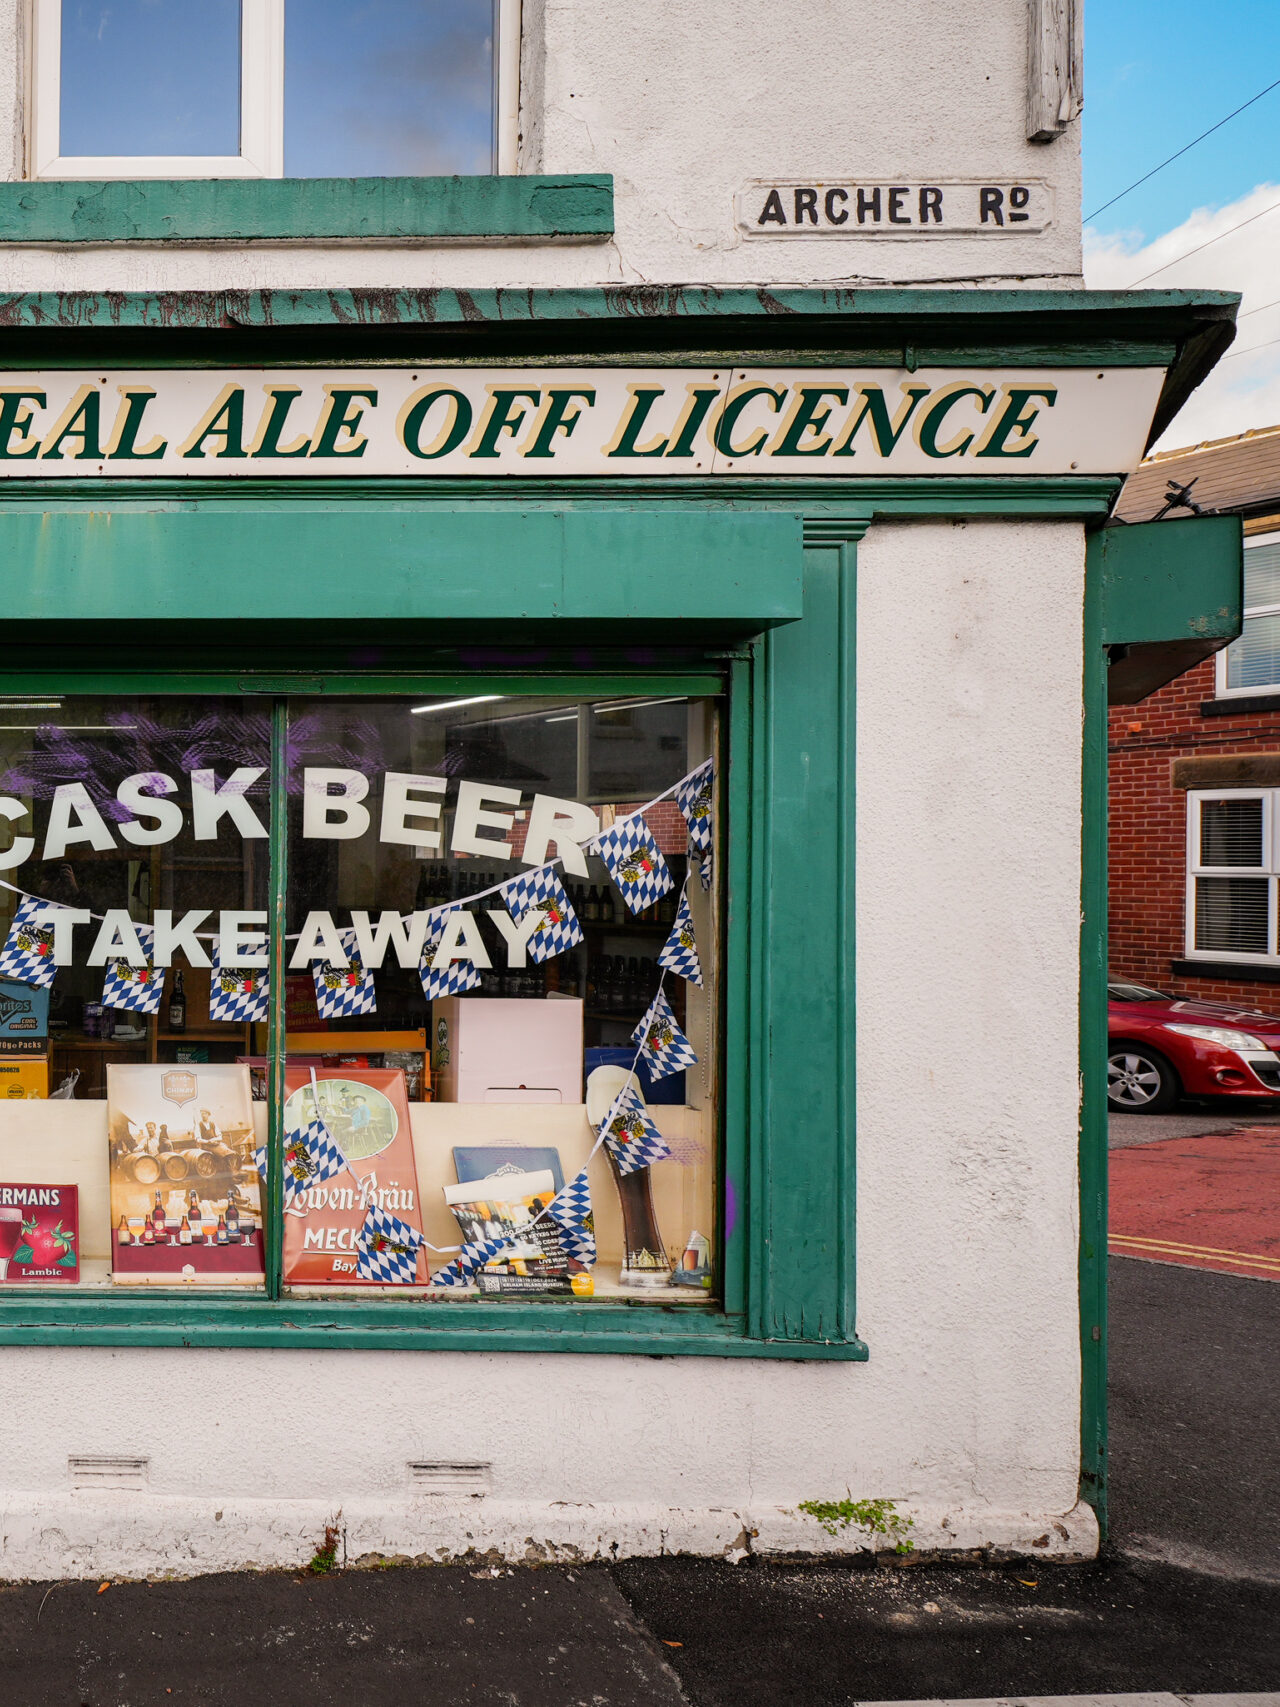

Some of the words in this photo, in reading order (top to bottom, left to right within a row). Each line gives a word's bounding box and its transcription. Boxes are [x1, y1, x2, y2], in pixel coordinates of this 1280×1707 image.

[758, 187, 944, 226] ARCHER
[176, 383, 379, 459] ALE
[397, 383, 596, 459] OFF
[602, 381, 1058, 458] LICENCE
[303, 766, 597, 879] BEER
[18, 1041, 42, 1049] Packs
[535, 1222, 557, 1230] BEERS
[22, 1267, 62, 1277] Lambic
